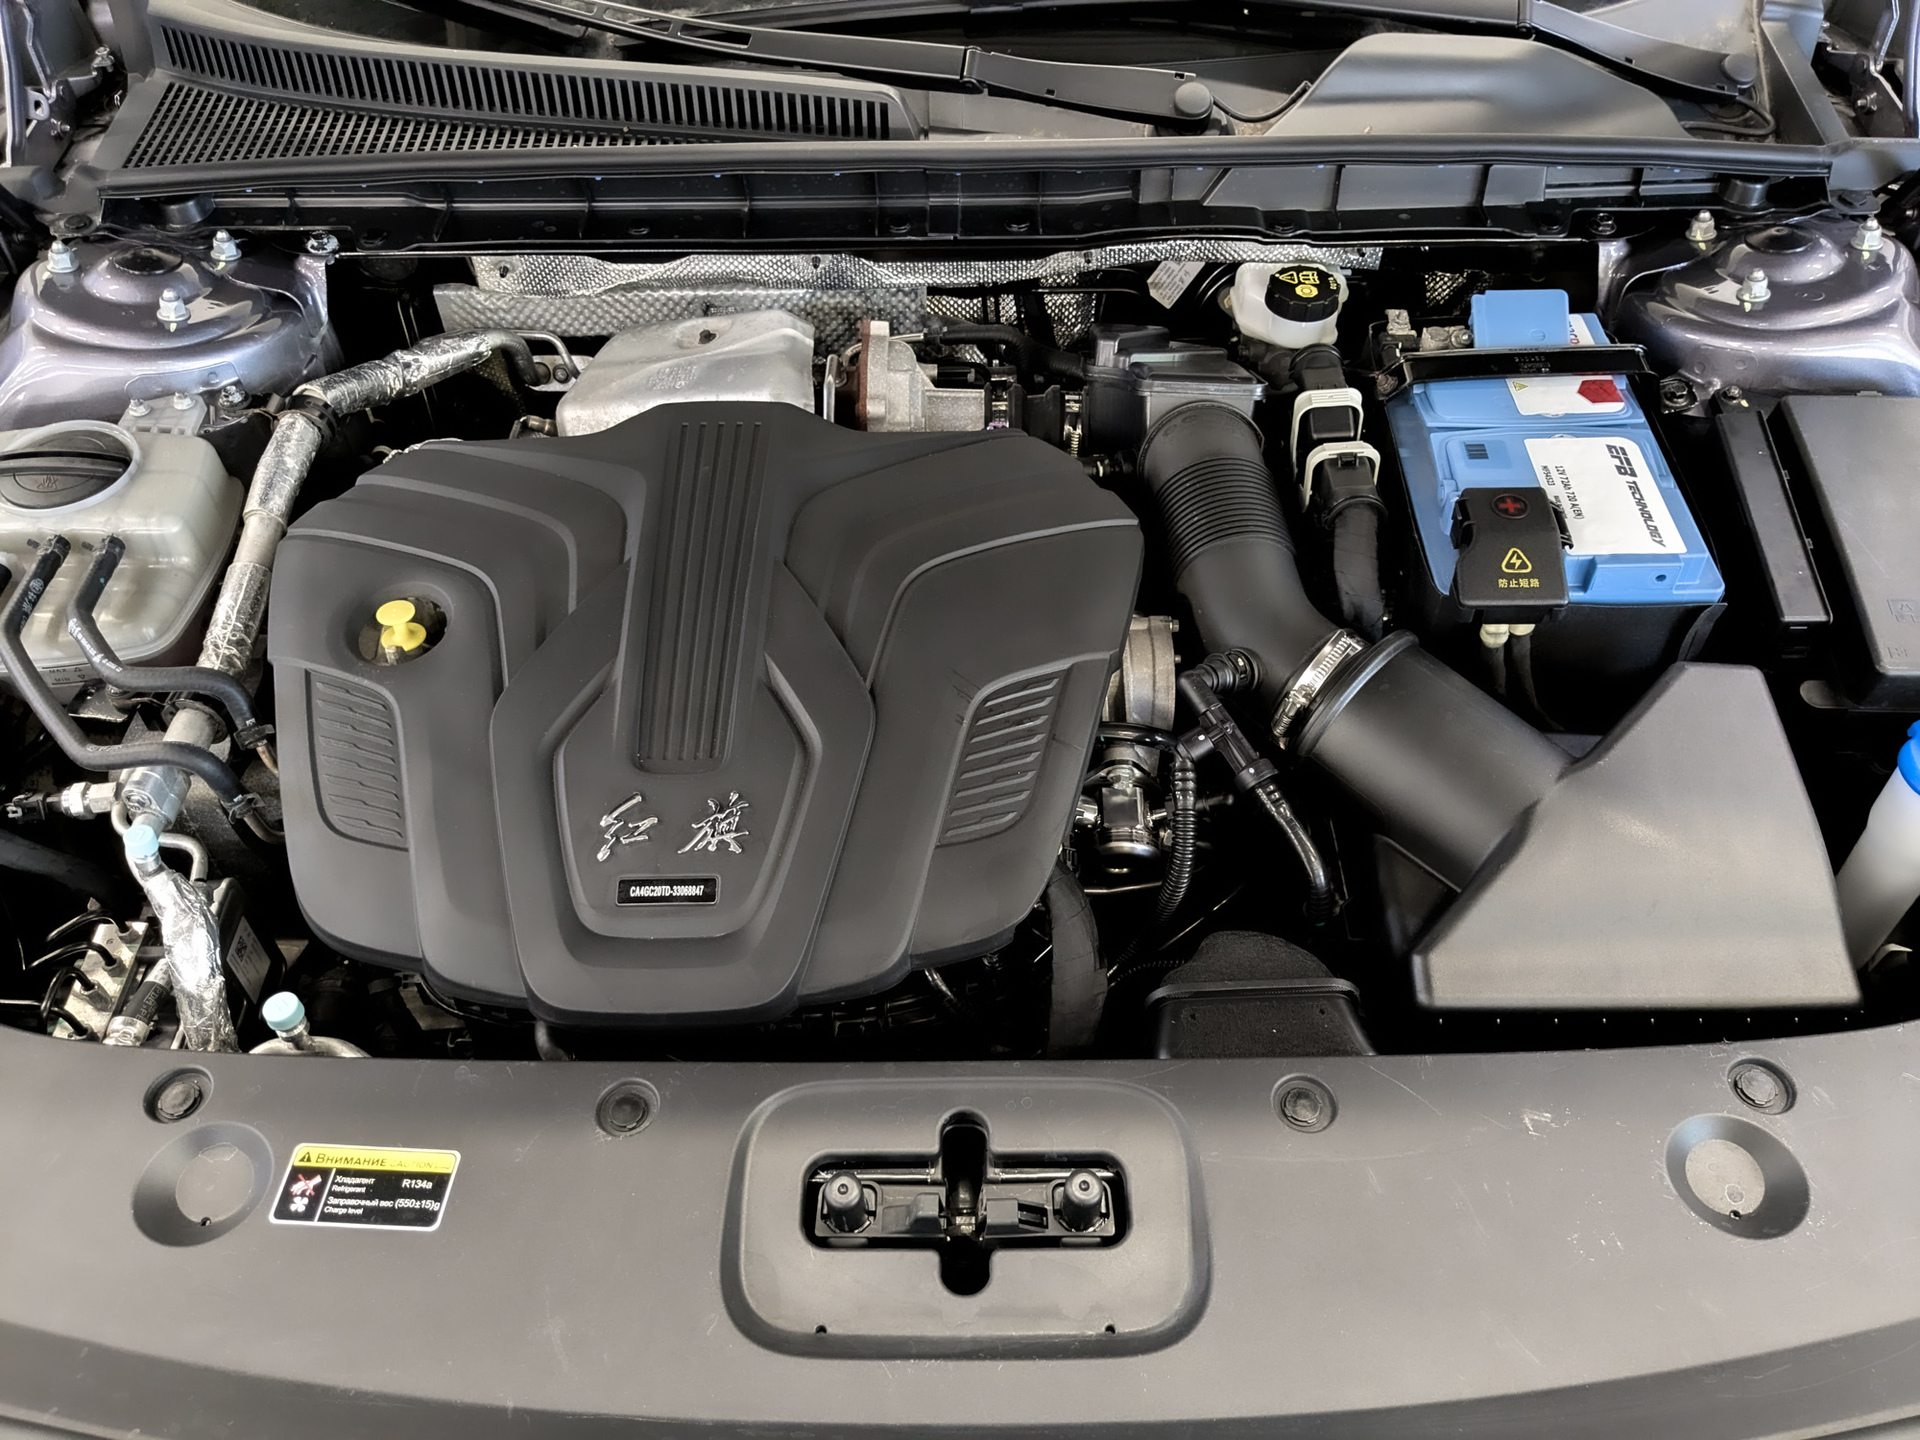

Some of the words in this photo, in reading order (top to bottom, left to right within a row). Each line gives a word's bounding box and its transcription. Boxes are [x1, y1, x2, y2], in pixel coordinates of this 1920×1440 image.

[1555, 465, 1567, 475] 12V
[1565, 491, 1578, 502] 720
[1605, 443, 1638, 478] EFB
[1625, 479, 1667, 548] TECHNOLOGY
[1498, 578, 1540, 588] 防止短路
[597, 791, 750, 861] 红旗
[335, 1175, 376, 1185] Хладагент
[402, 1178, 433, 1189] R134a
[332, 1185, 367, 1194] Refrigerant
[394, 1198, 441, 1211] (550±15)g
[324, 1206, 348, 1215] Charge
[348, 1207, 363, 1215] level
